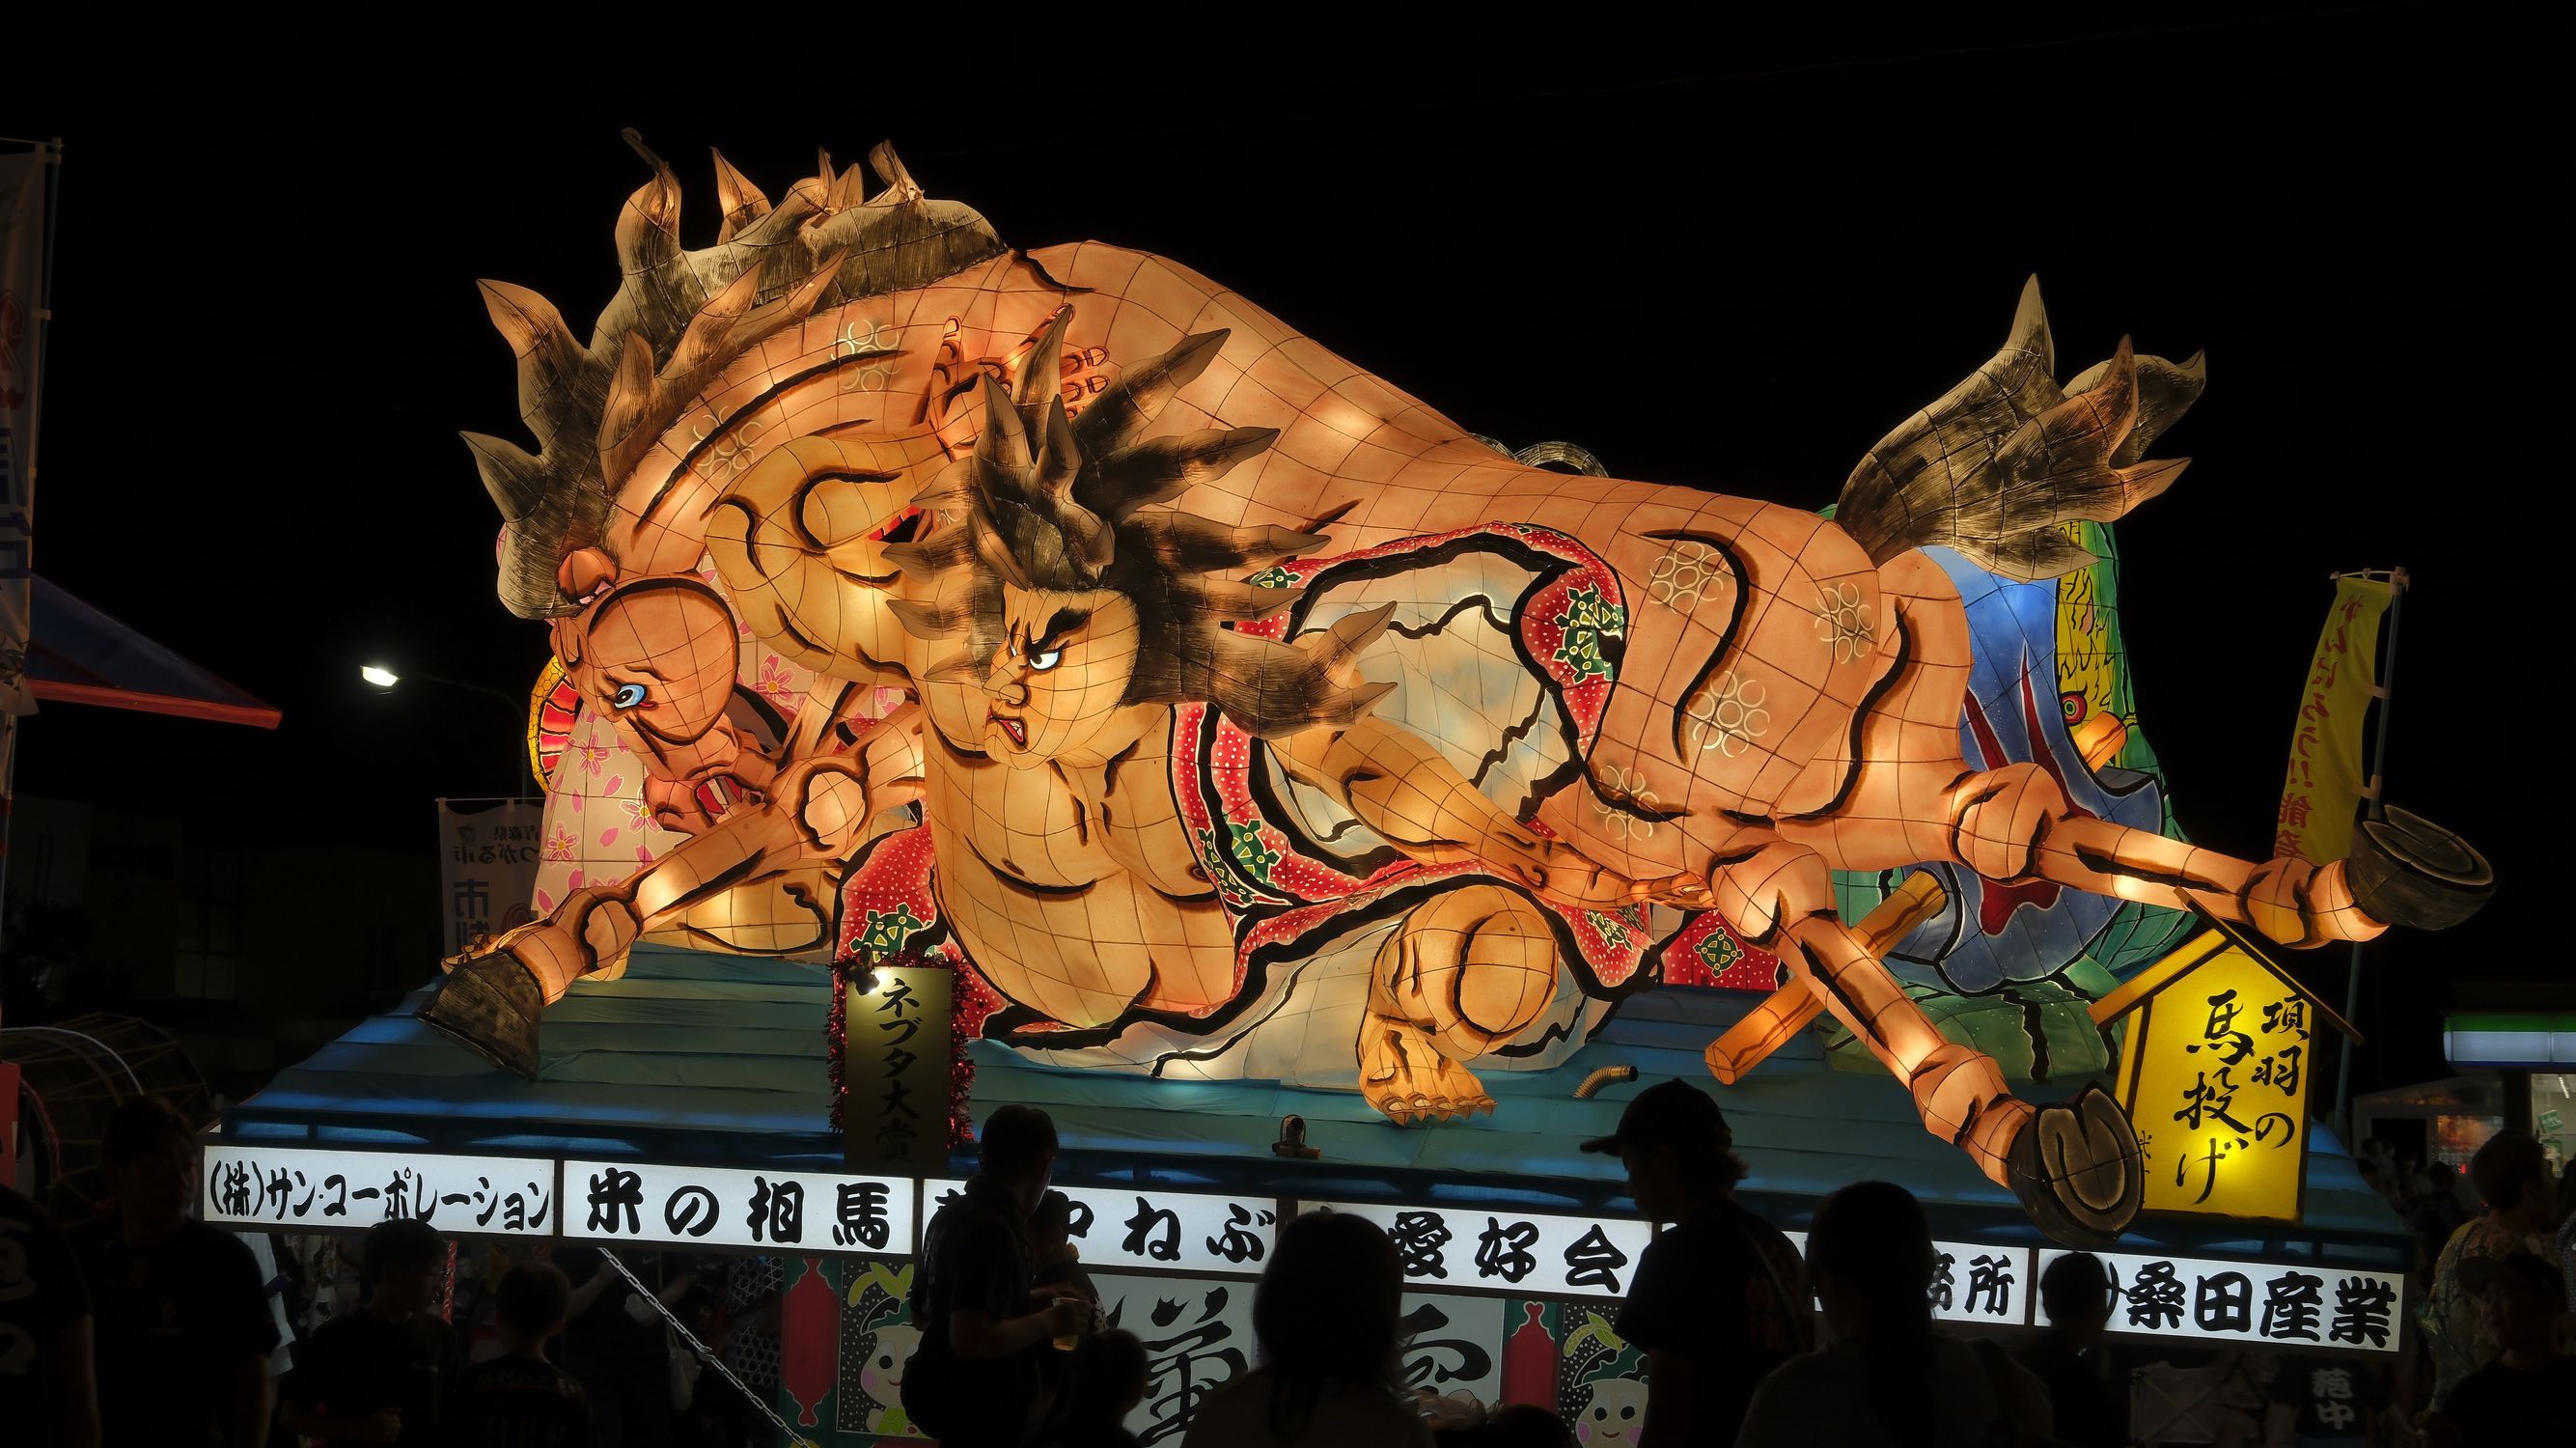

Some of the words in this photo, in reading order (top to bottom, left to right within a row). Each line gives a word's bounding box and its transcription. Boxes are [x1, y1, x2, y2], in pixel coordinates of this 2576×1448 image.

[874, 978, 923, 1164] ネブタ大賞
[2174, 989, 2255, 1206] 馬投げ
[2251, 994, 2311, 1150] 項羽の
[1320, 1206, 1627, 1294] 愛好会
[2105, 1261, 2394, 1349] )桑田産業
